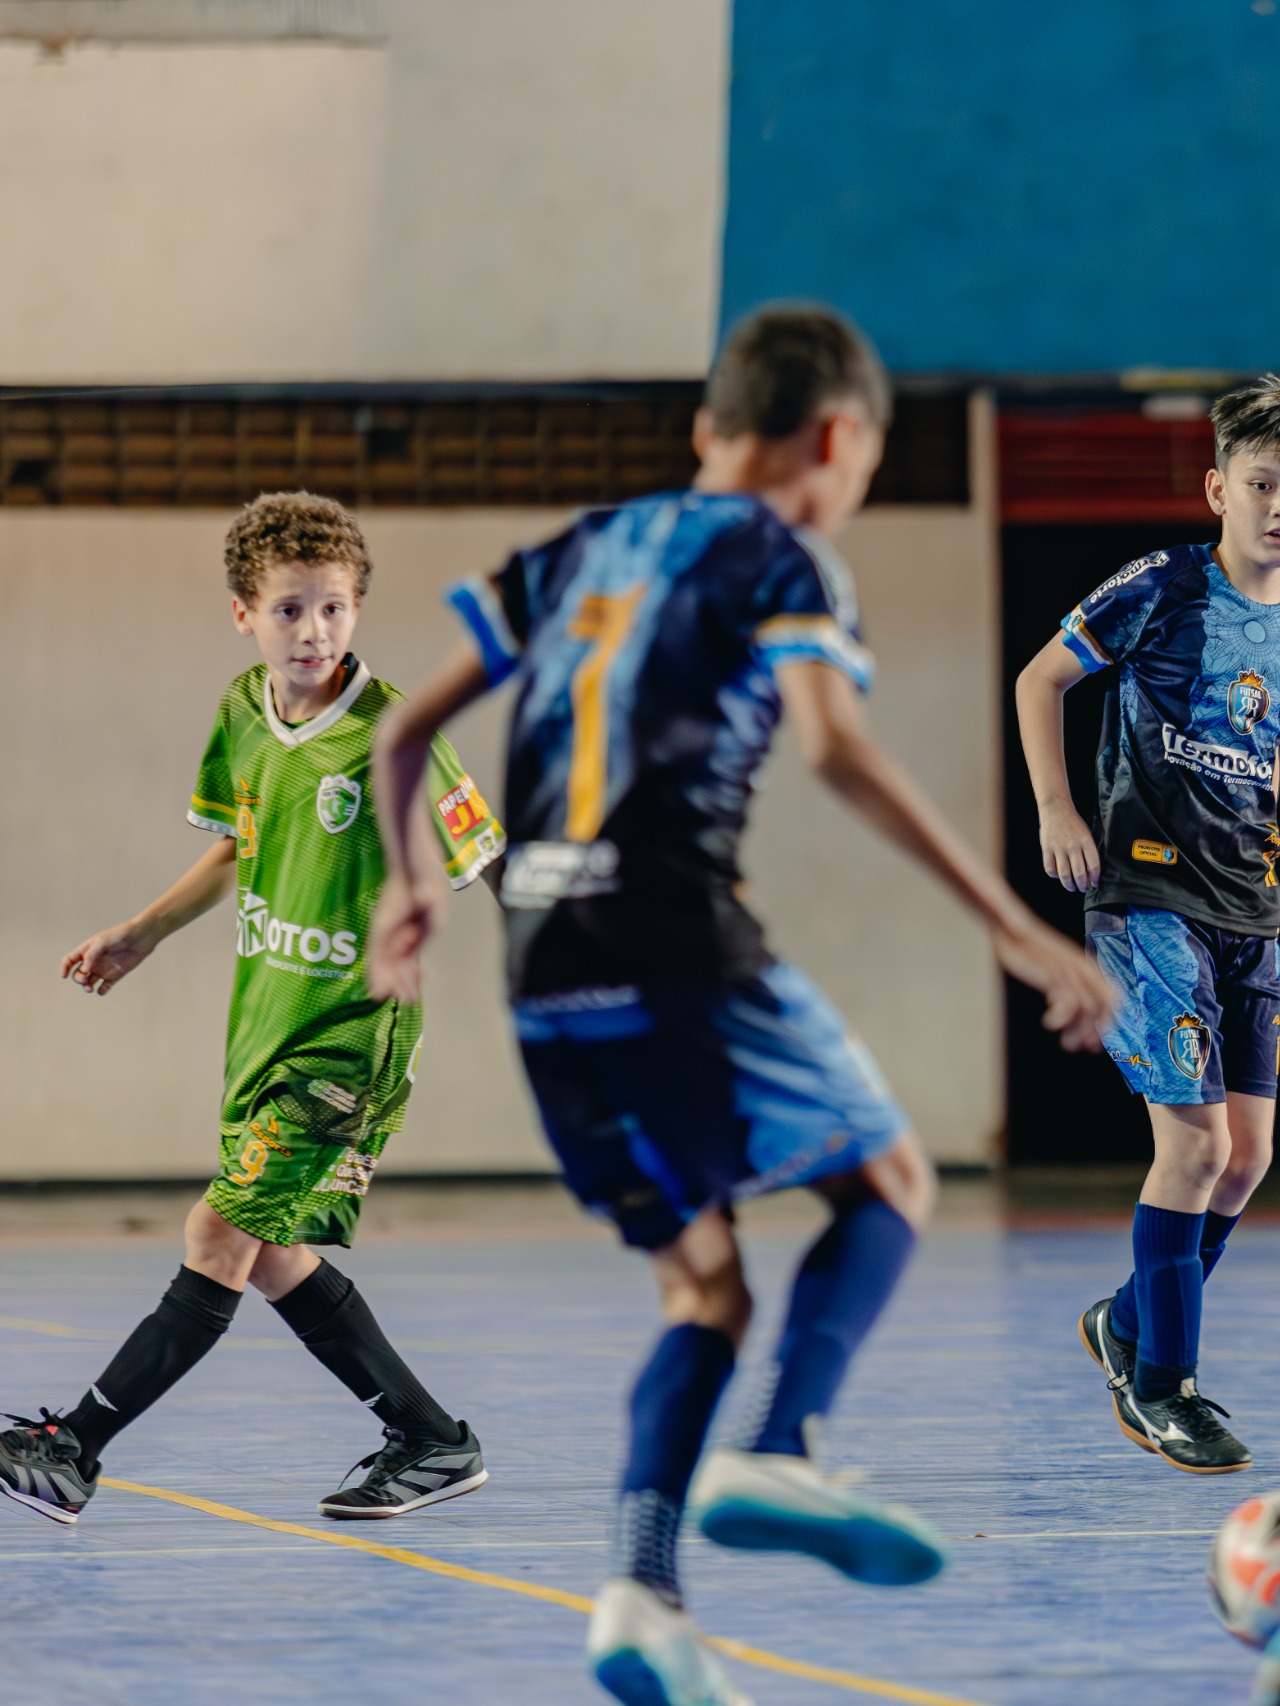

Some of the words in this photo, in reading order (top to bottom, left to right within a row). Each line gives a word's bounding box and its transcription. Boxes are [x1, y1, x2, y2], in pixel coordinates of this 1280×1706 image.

[1240, 687, 1261, 699] FUTSAL
[237, 804, 258, 859] 9
[1180, 1029, 1200, 1039] FUTSAL
[229, 1140, 269, 1187] 9
